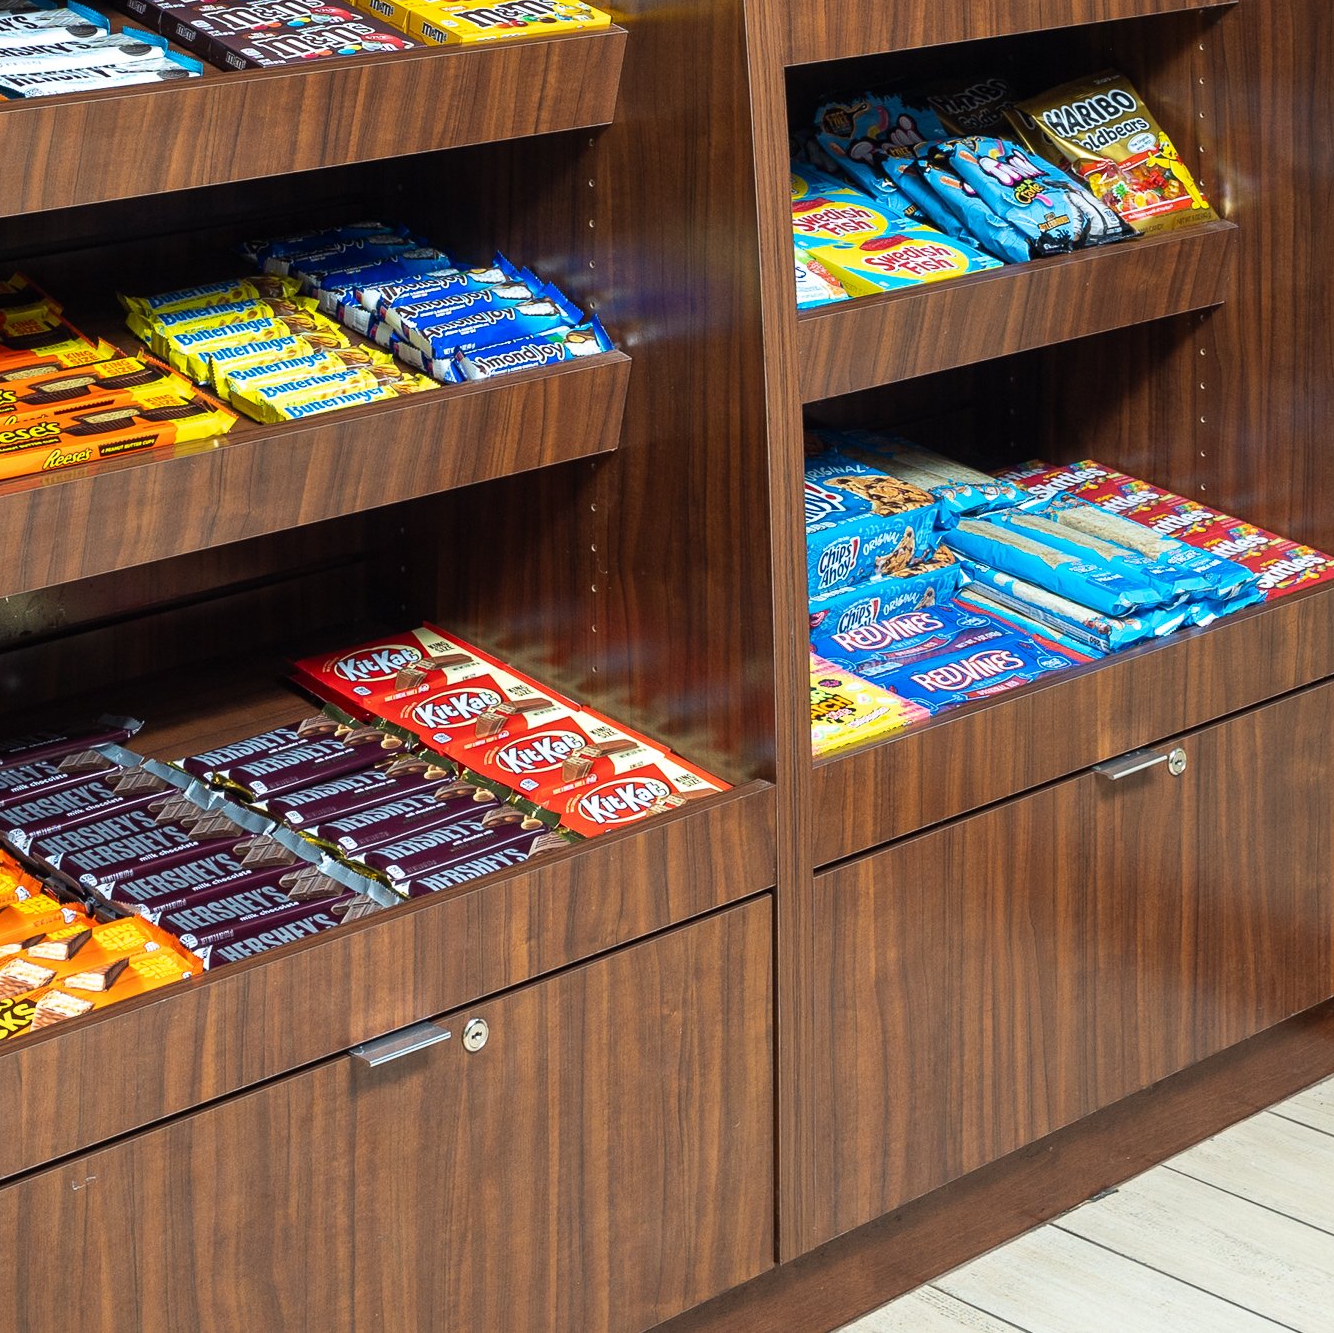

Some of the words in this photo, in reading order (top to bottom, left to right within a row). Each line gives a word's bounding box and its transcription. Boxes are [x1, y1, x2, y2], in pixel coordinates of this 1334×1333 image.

[1043, 89, 1136, 137] HARIBO
[794, 206, 871, 232] Swedish
[864, 243, 955, 273] Swedish
[176, 319, 273, 346] Butterfinger
[0, 782, 115, 827] HERSHEY'S
